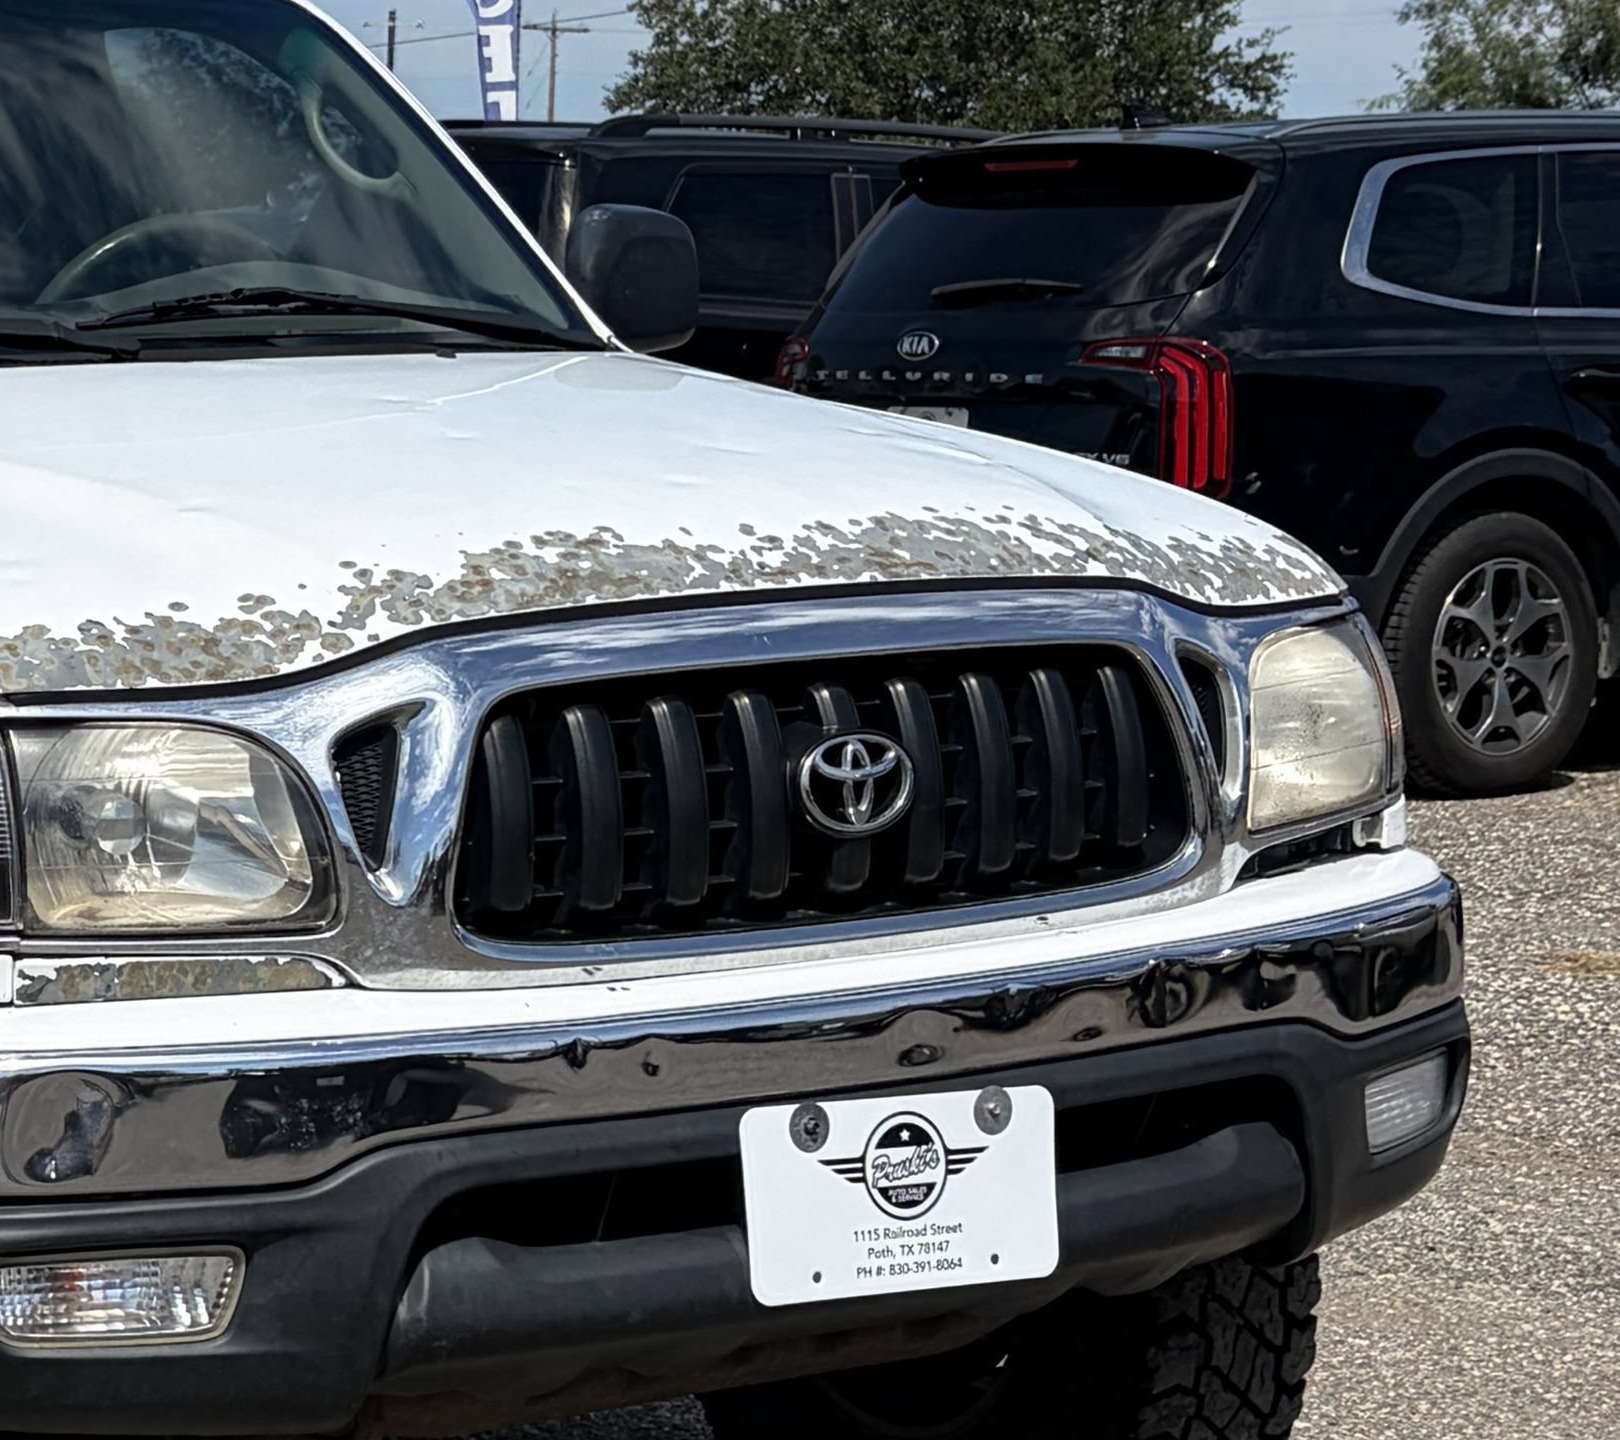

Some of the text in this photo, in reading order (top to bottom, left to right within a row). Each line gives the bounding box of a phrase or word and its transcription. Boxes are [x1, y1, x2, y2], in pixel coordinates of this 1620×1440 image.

[901, 335, 930, 354] KIA
[815, 369, 1044, 384] TELLURIDE
[871, 1141, 940, 1189] Pruski's
[853, 1222, 963, 1243] 1115 Railroad Street
[867, 1239, 950, 1260] Poth, TX 78147
[856, 1256, 963, 1279] PH #: 830-391-8064
